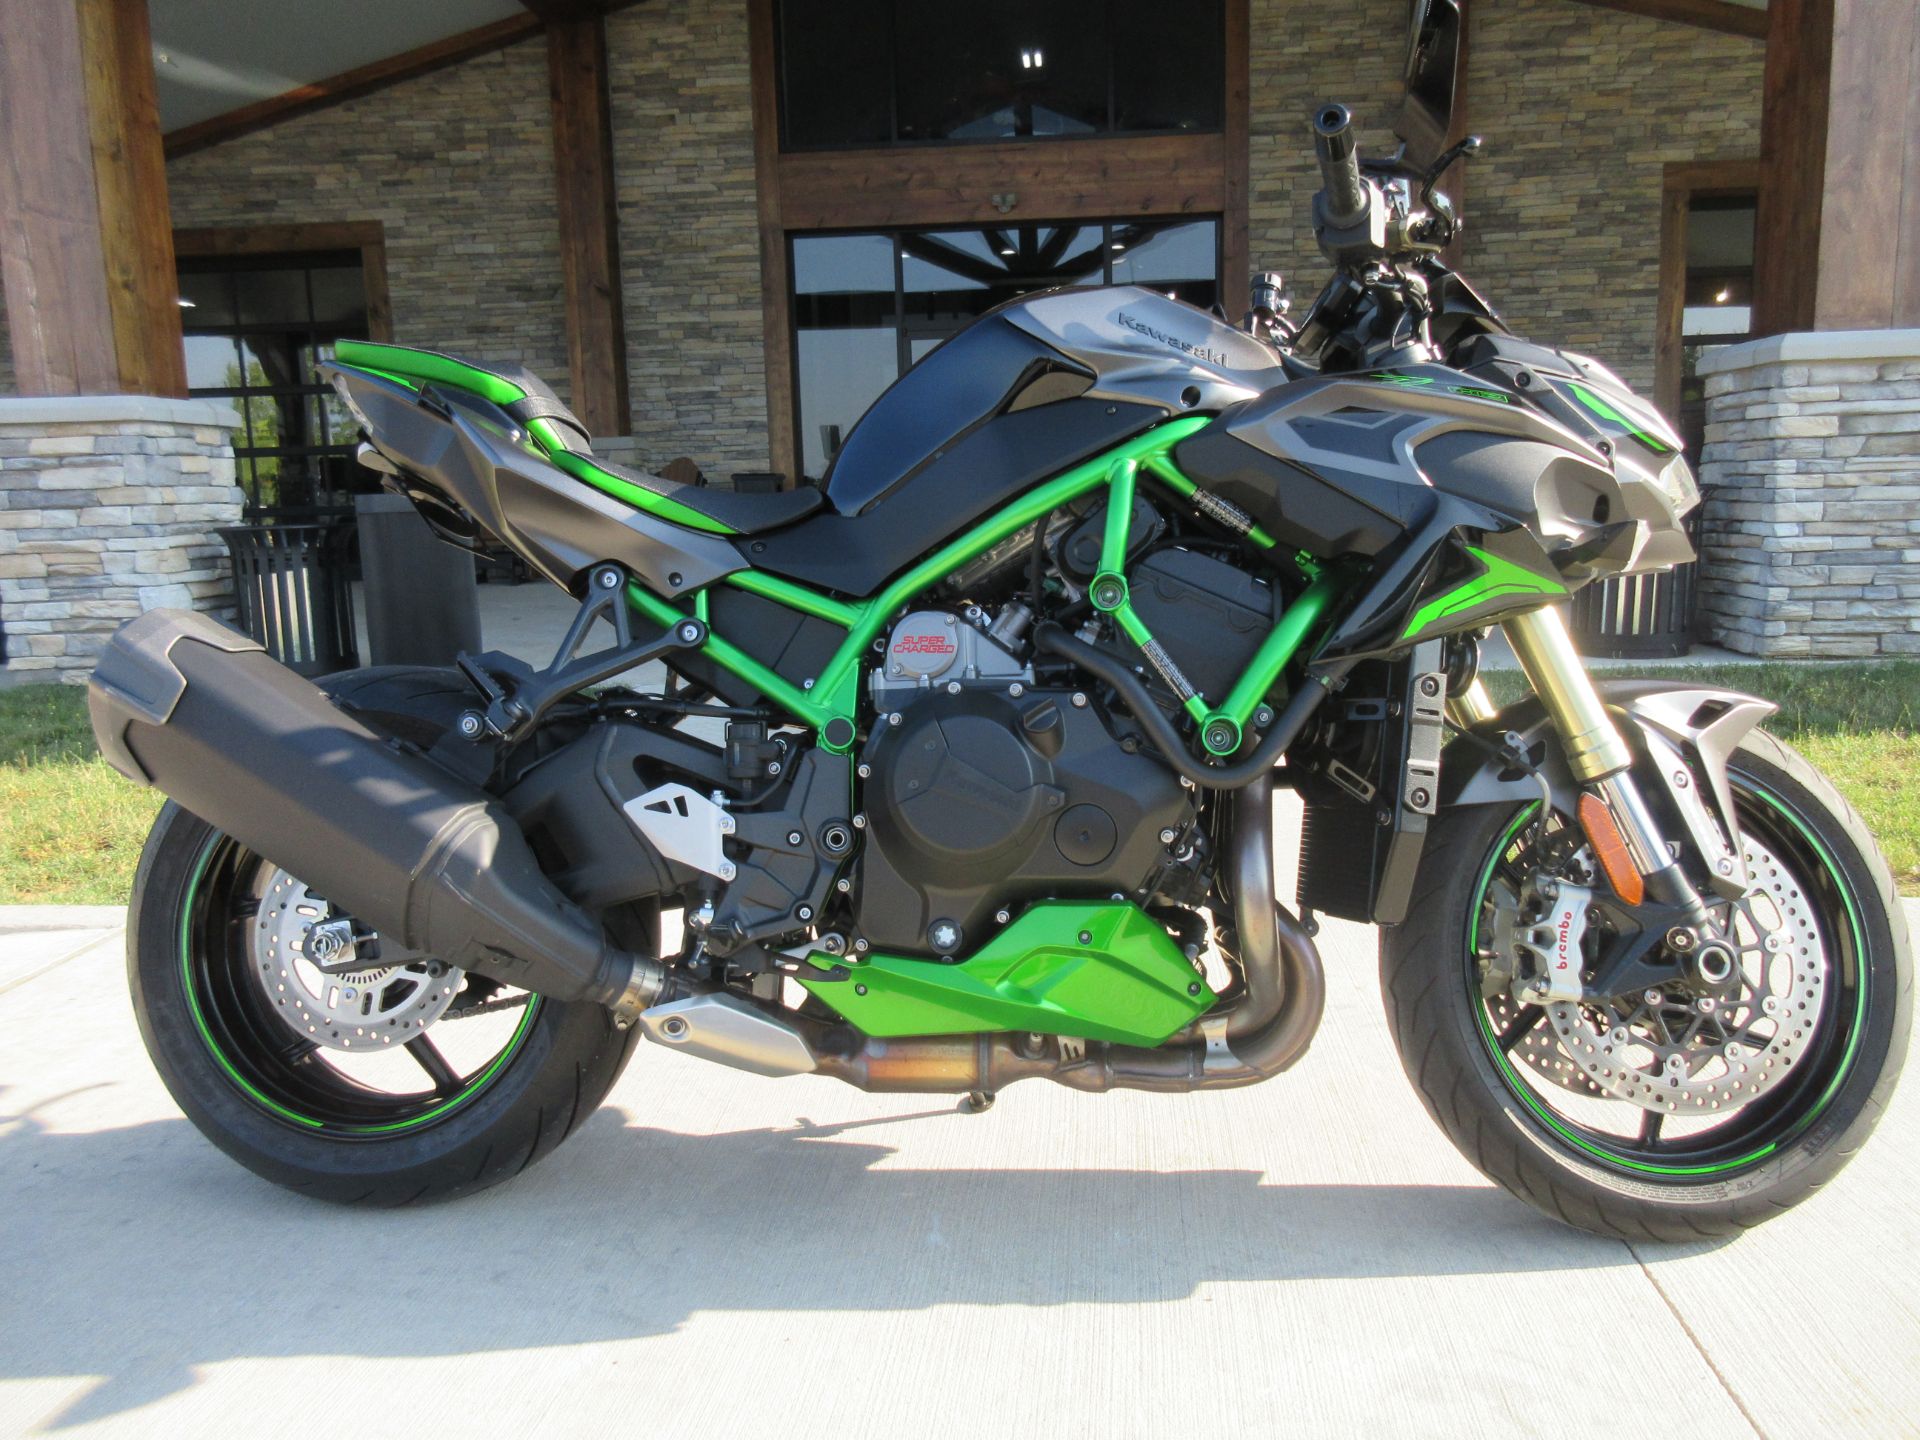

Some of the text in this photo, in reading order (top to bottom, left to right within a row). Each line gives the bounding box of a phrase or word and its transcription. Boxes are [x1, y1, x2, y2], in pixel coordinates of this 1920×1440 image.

[1118, 312, 1229, 368] Kawasaki
[893, 644, 955, 654] CHARGED
[901, 635, 946, 645] SUPER
[1556, 911, 1573, 970] brembo
